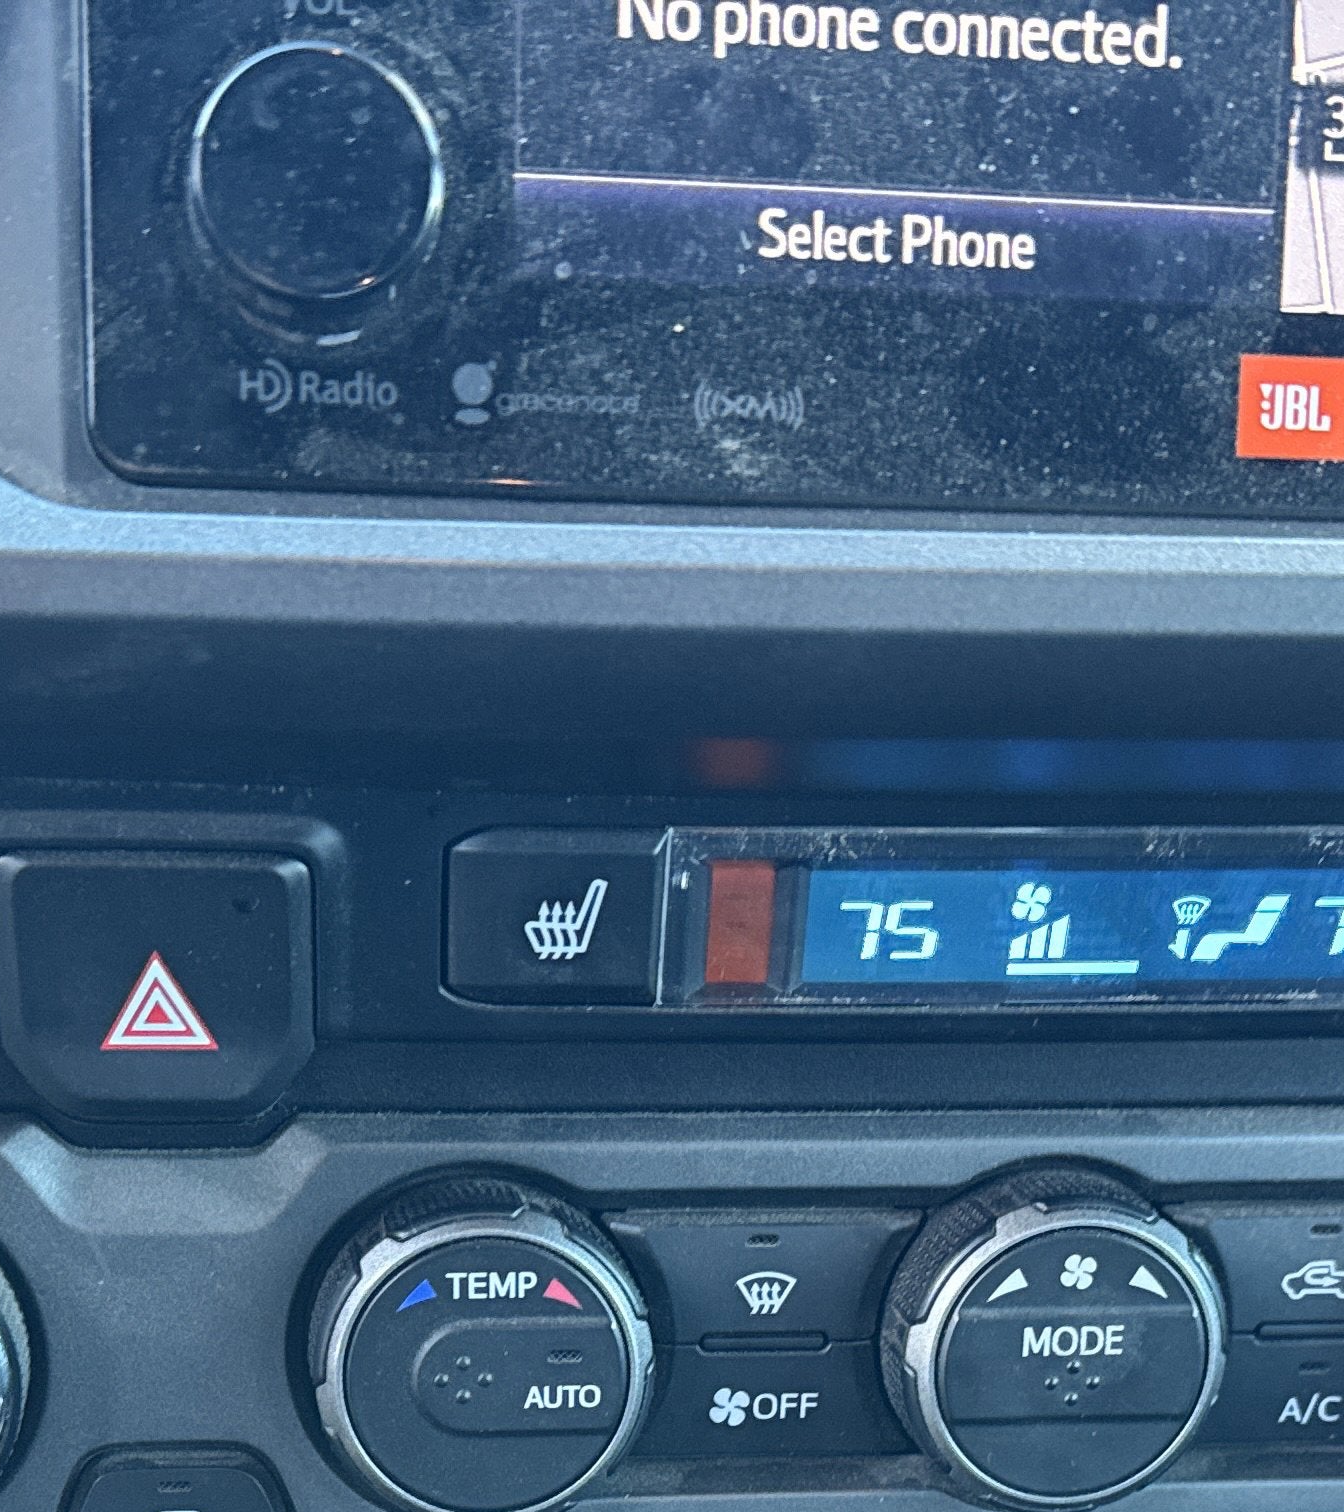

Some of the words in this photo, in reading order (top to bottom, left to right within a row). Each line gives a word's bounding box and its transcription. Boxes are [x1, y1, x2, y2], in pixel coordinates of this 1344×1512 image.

[616, 0, 701, 42] No
[713, 0, 881, 58] phone
[893, 2, 1184, 70] connected.
[758, 207, 893, 265] Select
[902, 213, 1036, 270] Phone
[298, 370, 399, 407] Radio
[840, 899, 941, 961] 75
[445, 1270, 538, 1301] TEMP
[1021, 1324, 1126, 1358] MODE
[523, 1383, 602, 1410] AUTO
[752, 1392, 820, 1421] OFF
[1277, 1393, 1343, 1425] A/C
